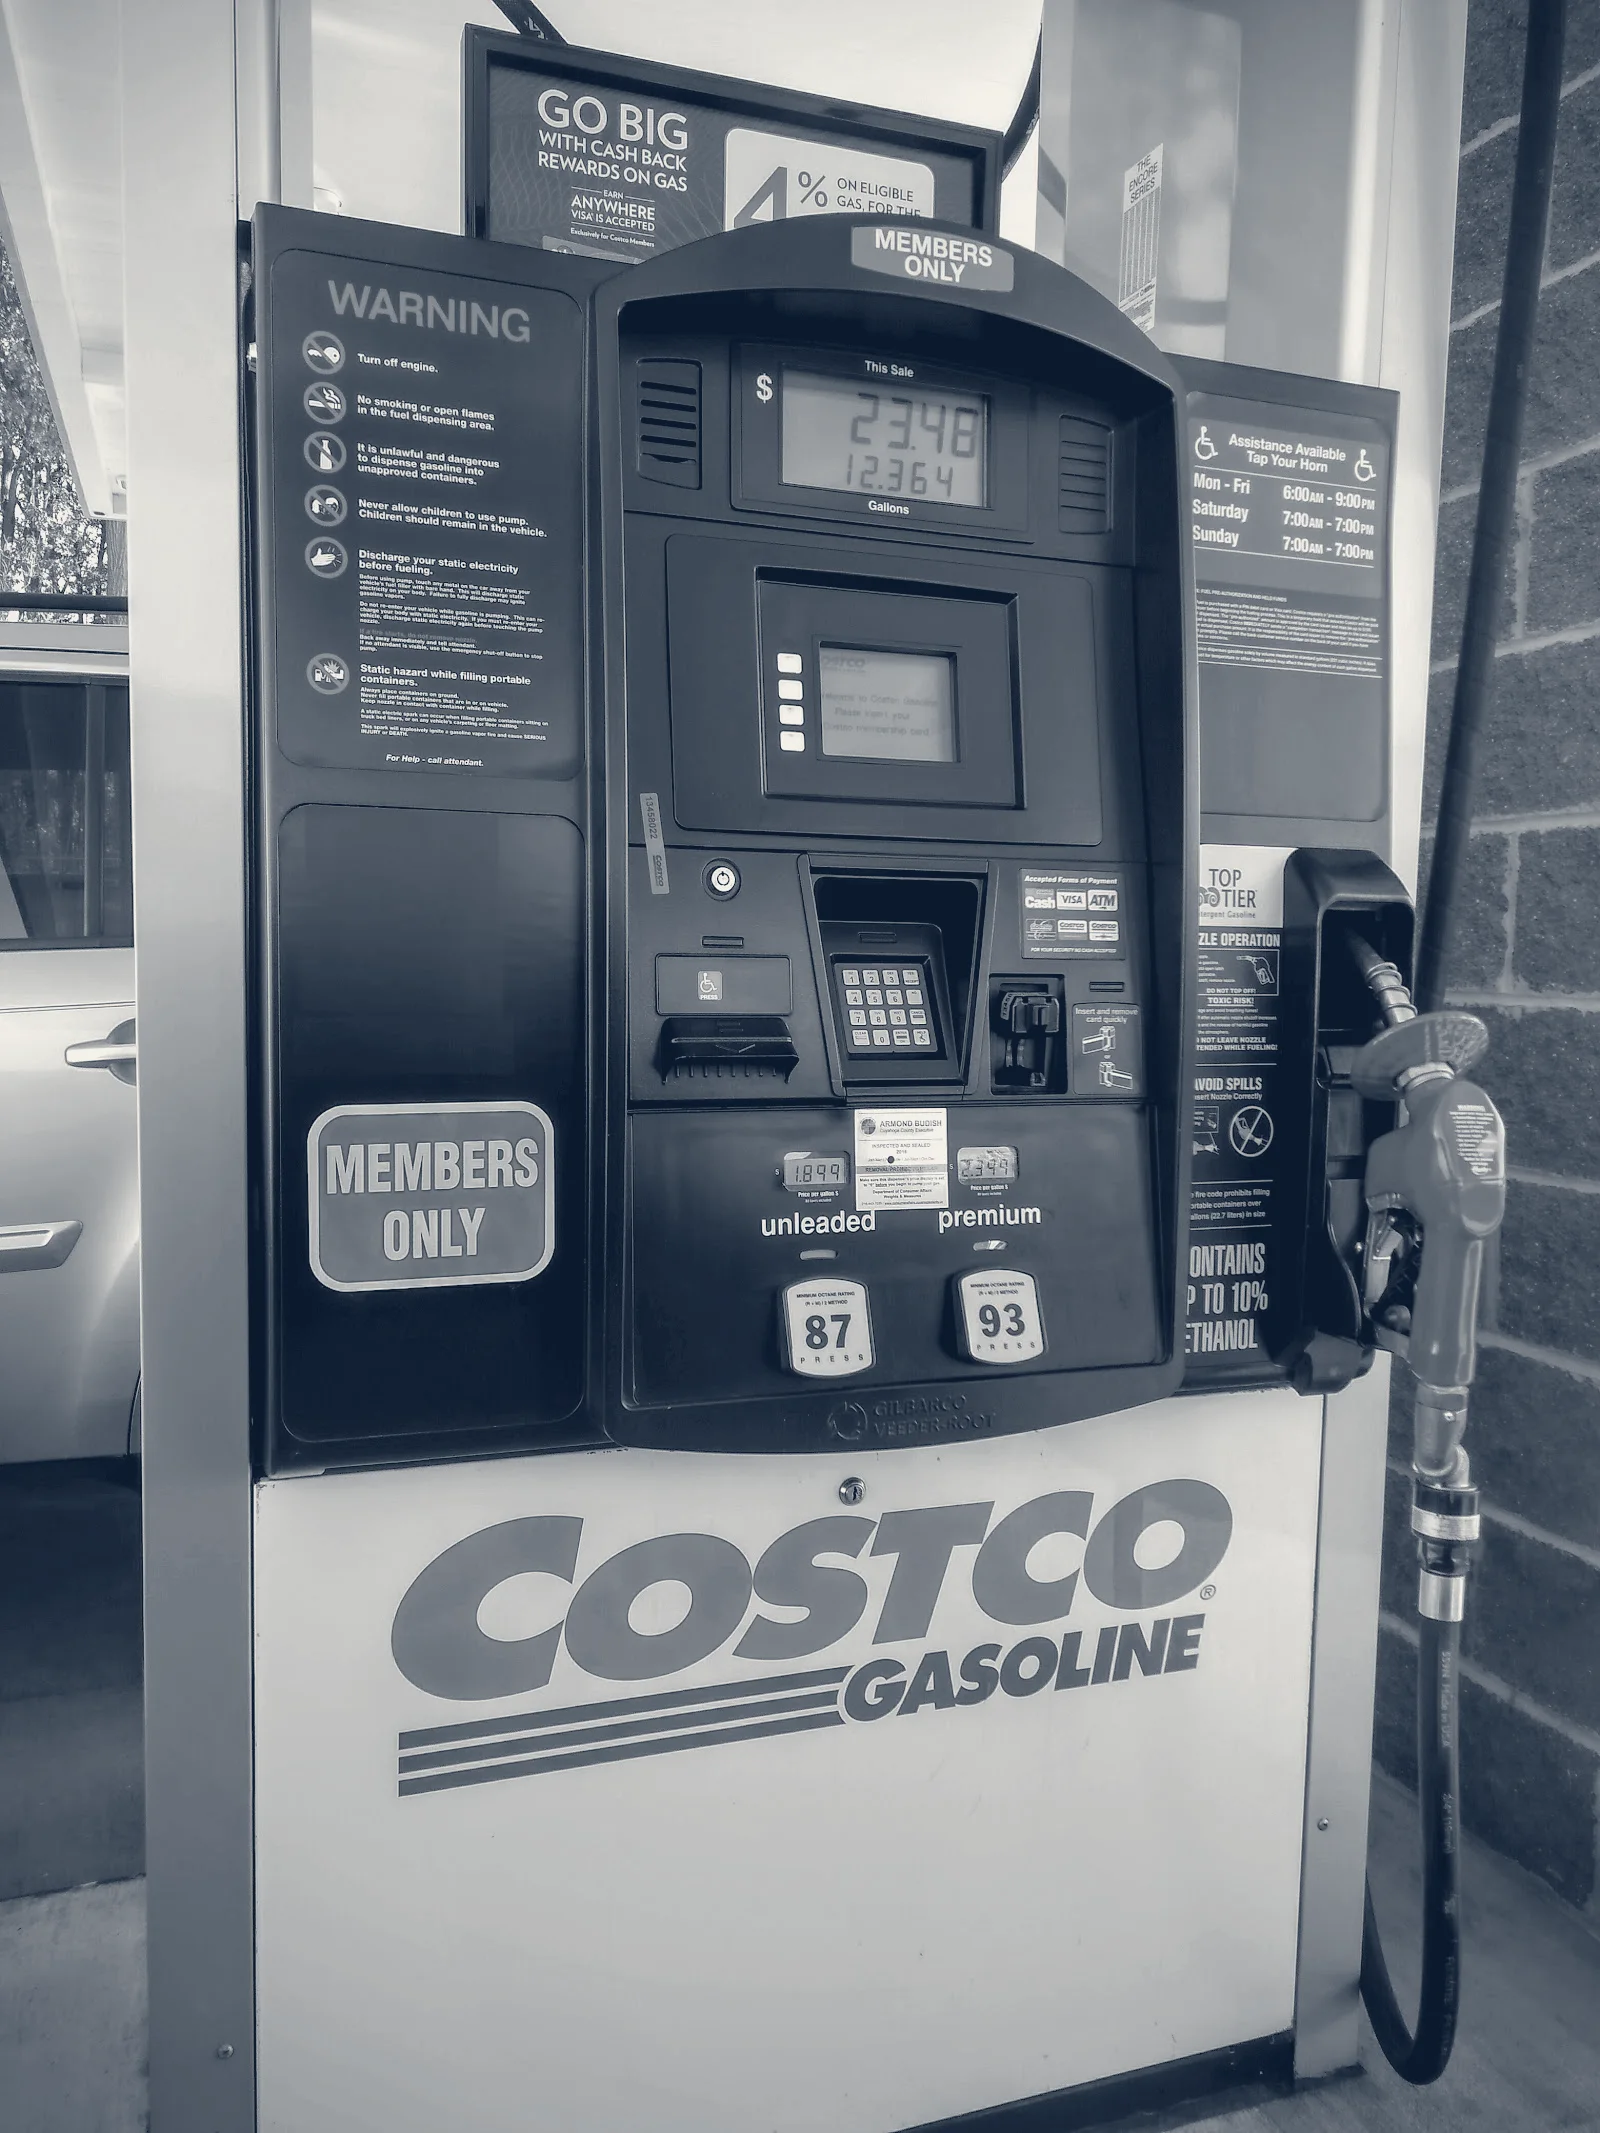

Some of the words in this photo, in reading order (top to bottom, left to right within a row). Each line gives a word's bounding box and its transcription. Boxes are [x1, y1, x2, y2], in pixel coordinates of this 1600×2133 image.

[538, 89, 607, 134] GO
[620, 103, 688, 150] BIG
[539, 130, 586, 153] WITH
[591, 140, 637, 163] CASH
[642, 149, 687, 172] BACK
[1137, 154, 1151, 173] THE
[538, 151, 619, 180] REWARDS
[623, 167, 650, 185] ON
[654, 173, 688, 192] GAS
[1129, 162, 1158, 192] ENCORE
[603, 190, 624, 199] EARN
[837, 178, 857, 192] ON
[860, 182, 914, 202] ELIGIBLE
[1130, 177, 1155, 204] SERIES
[571, 195, 655, 220] ANYWHERE
[837, 195, 865, 212] GAS,
[868, 201, 894, 215] FOR
[596, 213, 603, 222] IS
[606, 216, 655, 231] ACCEPTED
[571, 228, 600, 239] Exclusively
[610, 234, 629, 243] Costco
[630, 237, 655, 247] Members
[875, 228, 993, 267] MEMBERS
[904, 256, 965, 283] ONLY
[327, 280, 531, 343] WARNING
[357, 353, 381, 366] Turn
[384, 356, 398, 368] off
[400, 360, 439, 373] engine.
[865, 360, 888, 374] This
[891, 364, 914, 378] Sale
[756, 373, 773, 404] $
[357, 395, 372, 405] No
[374, 398, 417, 413] smoking
[420, 403, 432, 412] or
[433, 404, 460, 418] open
[461, 406, 495, 421] flames
[357, 405, 367, 414] in
[370, 406, 388, 417] the
[389, 408, 410, 420] fuel
[412, 412, 467, 429] dispensing
[469, 421, 495, 431] area.
[851, 392, 978, 458] 23.48
[357, 443, 365, 452] It
[368, 444, 377, 453] is
[380, 446, 423, 459] unlawful
[426, 450, 445, 462] and
[447, 453, 499, 469] dangerous
[1229, 433, 1293, 454] Assistance
[1295, 443, 1346, 462] Available
[357, 454, 368, 463] to
[371, 454, 417, 470] dispense
[420, 461, 462, 476] gasoline
[464, 465, 484, 476] into
[1247, 450, 1268, 467] Tap
[1271, 453, 1298, 468] Your
[1300, 459, 1328, 472] Horn
[357, 465, 418, 479] unapproved
[420, 471, 477, 485] containers.
[847, 454, 953, 497] 12.364
[1194, 472, 1221, 491] Mon
[1234, 478, 1250, 494] Fri
[1283, 485, 1324, 504] 6:00AM
[1335, 492, 1375, 510] 9:00PM
[359, 499, 389, 510] Never
[391, 502, 419, 514] allow
[421, 505, 462, 518] children
[465, 510, 475, 519] to
[478, 513, 496, 522] use
[498, 515, 528, 528] pump.
[868, 500, 910, 515] Gallons
[1193, 499, 1249, 523] Saturday
[1283, 511, 1323, 529] 7:00AM
[1335, 518, 1374, 536] 7:00PM
[359, 510, 402, 521] Children
[405, 514, 439, 526] should
[442, 519, 476, 530] remain
[479, 523, 488, 531] in
[491, 523, 508, 533] the
[510, 526, 547, 537] vehicle.
[1193, 525, 1239, 547] Sunday
[1283, 536, 1323, 554] 7:00AM
[1334, 543, 1374, 560] 7:00PM
[359, 550, 410, 563] Discharge
[413, 556, 436, 566] your
[438, 559, 466, 569] static
[469, 561, 519, 575] electricity
[359, 560, 392, 571] before
[395, 564, 433, 576] fueling.
[360, 664, 390, 675] Static
[394, 666, 427, 677] hazard
[431, 670, 457, 680] while
[460, 671, 487, 683] filling
[490, 674, 531, 685] portable
[360, 675, 418, 686] containers.
[386, 754, 400, 762] For
[401, 754, 420, 763] Help
[427, 756, 442, 764] call
[444, 758, 484, 766] attendant.
[645, 796, 658, 840] 13458022
[1024, 875, 1057, 883] Accepted
[1208, 869, 1242, 887] TOP
[1025, 896, 1056, 908] Cash
[1062, 895, 1083, 904] VISA
[1090, 895, 1116, 906] ATM
[1222, 889, 1256, 908] TIER
[1227, 910, 1256, 918] Gasoline
[1221, 934, 1280, 947] OPERATION
[1075, 1008, 1096, 1016] Insert
[1097, 1008, 1110, 1016] and
[1103, 1016, 1128, 1025] quickly
[1226, 1077, 1262, 1091] SPILLS
[326, 1138, 539, 1194] MEMBERS
[796, 1164, 840, 1182] 1.899
[761, 1210, 876, 1236] unleaded
[938, 1204, 1042, 1234] premium
[383, 1207, 486, 1261] ONLY
[1202, 1283, 1224, 1314] TO
[1232, 1280, 1268, 1312] 10%
[806, 1314, 851, 1350] 87
[979, 1303, 1025, 1338] 93
[390, 1477, 1233, 1702] COSTCO
[843, 1612, 1205, 1723] GASOLINE
